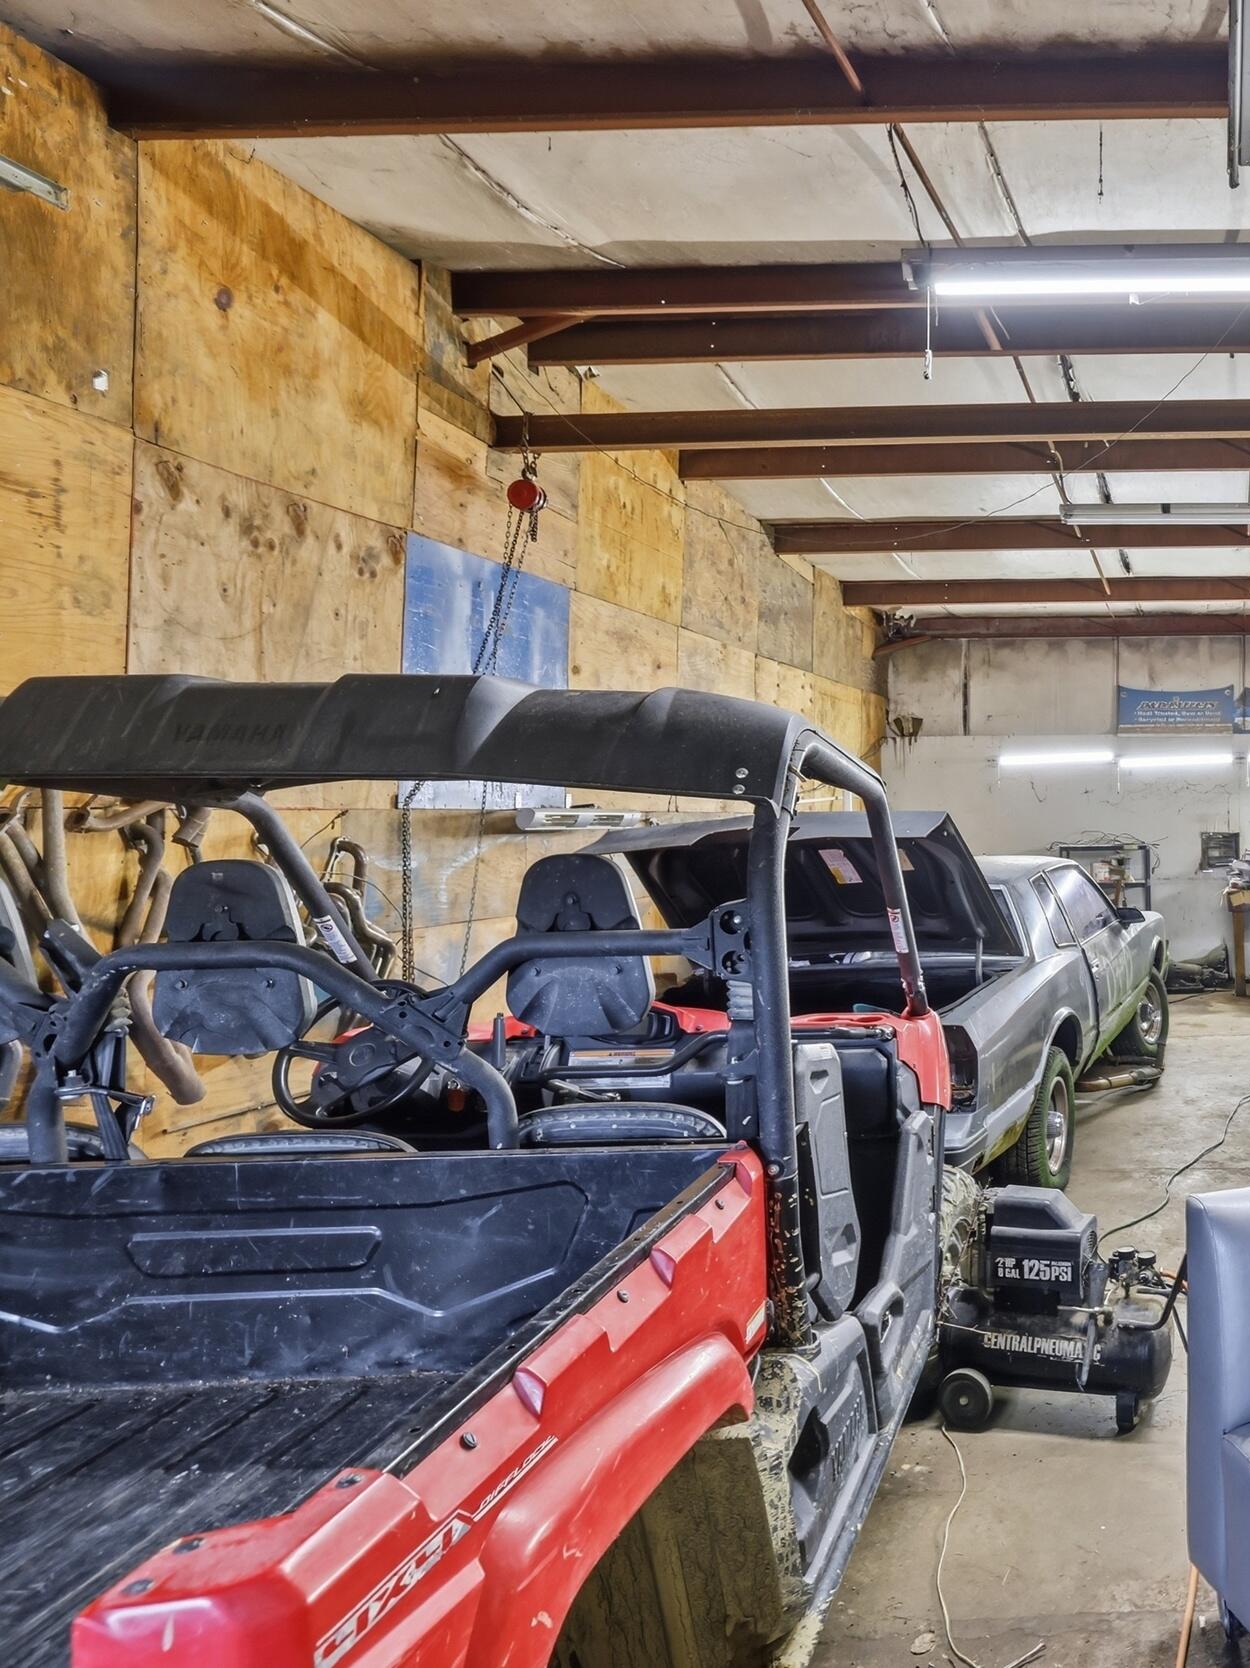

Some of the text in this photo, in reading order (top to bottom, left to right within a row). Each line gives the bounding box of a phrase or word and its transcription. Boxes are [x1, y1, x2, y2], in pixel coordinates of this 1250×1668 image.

[174, 722, 288, 743] YAMAHA
[1005, 1267, 1021, 1279] GAL
[1022, 1258, 1051, 1281] 125
[1050, 1266, 1073, 1282] PSI
